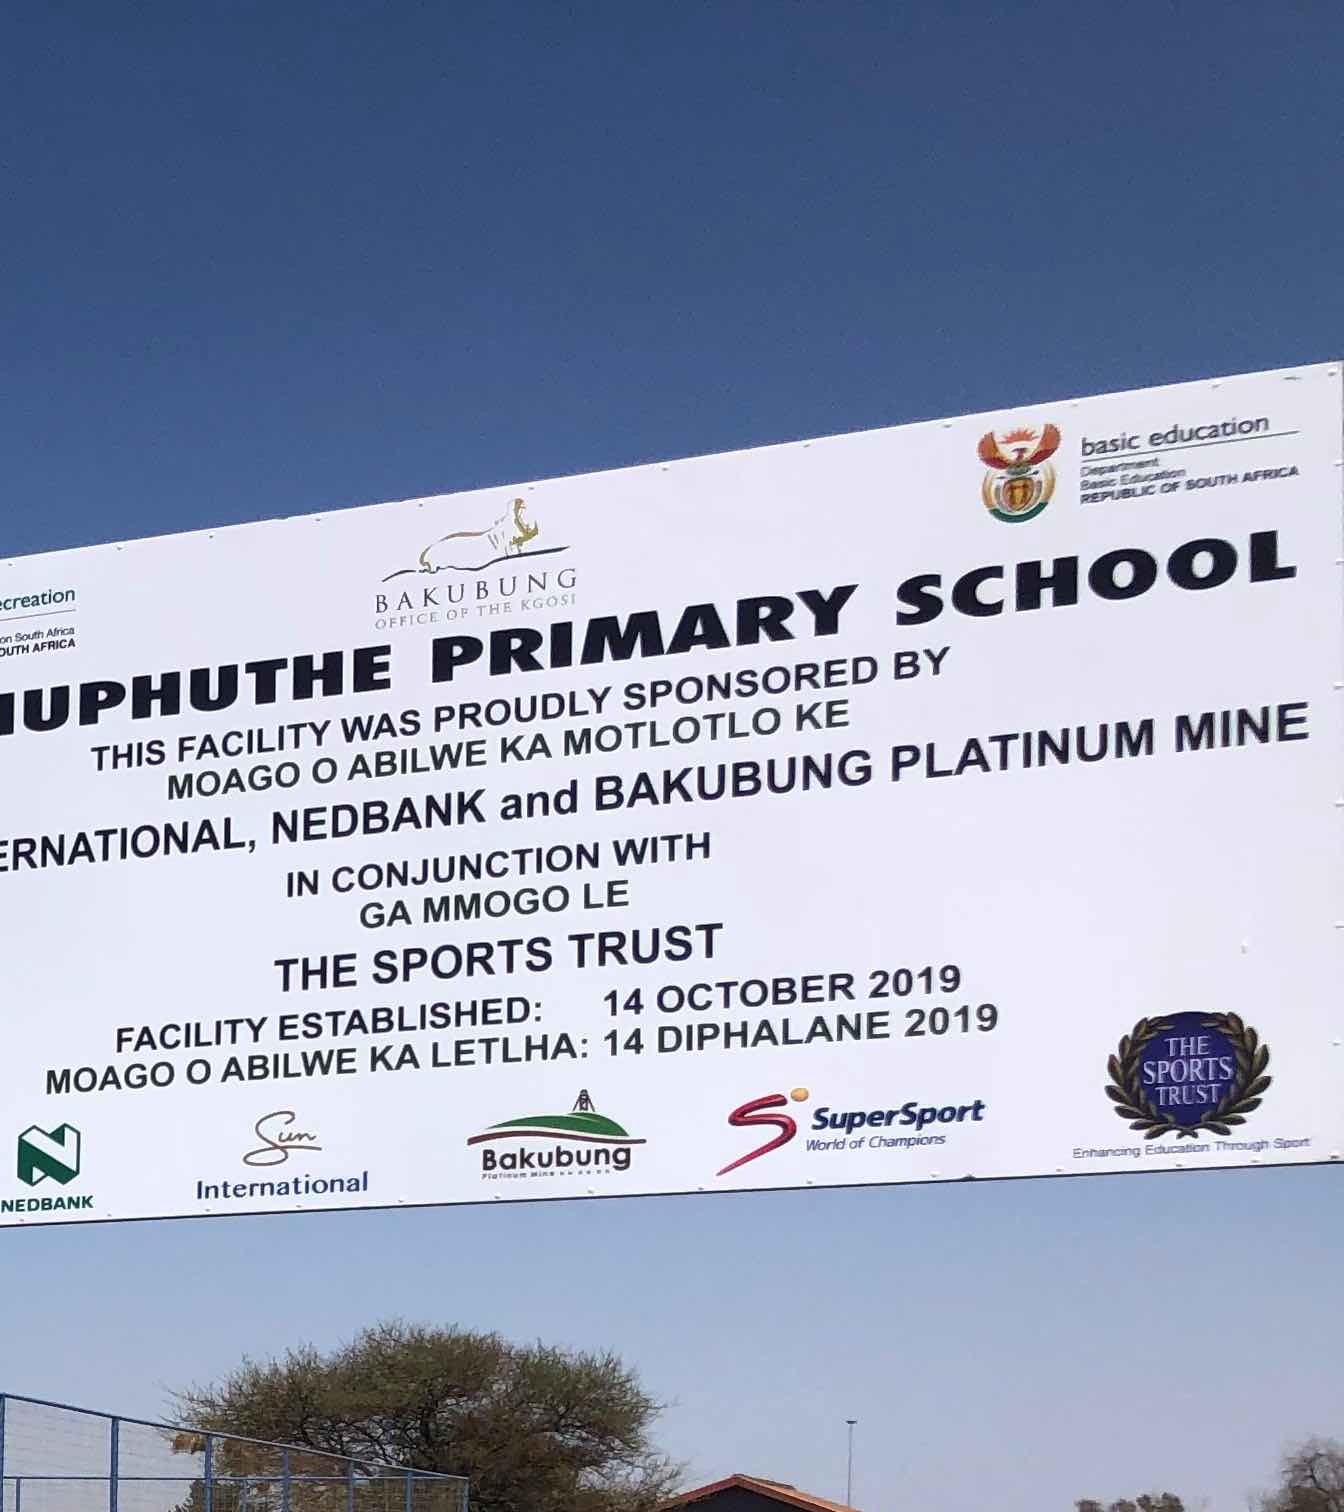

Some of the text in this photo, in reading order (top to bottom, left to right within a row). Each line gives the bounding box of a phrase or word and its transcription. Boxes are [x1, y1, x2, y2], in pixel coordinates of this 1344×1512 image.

[1081, 416, 1270, 457] basic education
[1080, 468, 1187, 491] Basic Education
[1080, 465, 1300, 504] REPUBLIC OF SOUTH AFRICA
[375, 568, 577, 614] BAKUBUNG
[431, 583, 860, 684] PRIMARY
[895, 529, 1298, 626] SCHOOL
[375, 594, 577, 630] OFFICE OF THE KGOSI
[15, 631, 44, 643] South
[46, 626, 76, 638] Africa
[32, 638, 76, 653] AFRICA
[90, 646, 951, 772] THIS FACILITY WAS PROUDLY SPONSORED BY
[167, 699, 850, 801] MOAGO O ABILWE KA MOTLOTLO KE
[272, 788, 486, 845] NEDBANK
[500, 779, 578, 821] and
[595, 749, 873, 811] BAKUBUNG
[891, 718, 1155, 782] PLATINUM
[1175, 701, 1310, 753] MINE
[287, 831, 711, 898] IN CONJUNCTION WITH
[359, 879, 629, 929] GA MMOGO LE
[273, 922, 724, 993] THE SPORTS TRUST
[116, 964, 961, 1054] FACILITY ESTABLISHED: 14 OCTOBER 2019
[46, 1003, 998, 1095] MOAGO O ABILWE KA LETLHA: 14 DIPHALANE 2019
[1165, 1035, 1210, 1057] THE
[1143, 1056, 1234, 1084] SPORTS
[1155, 1083, 1222, 1106] TRUST
[811, 1099, 986, 1135] SuperSport
[242, 1110, 323, 1167] Sun
[805, 1133, 946, 1152] World of Champions
[1072, 1137, 1312, 1160] Enhancing Education Through Sport
[481, 1145, 632, 1171] Bakubung
[0, 1193, 94, 1214] NEDBANK
[194, 1171, 369, 1201] International
